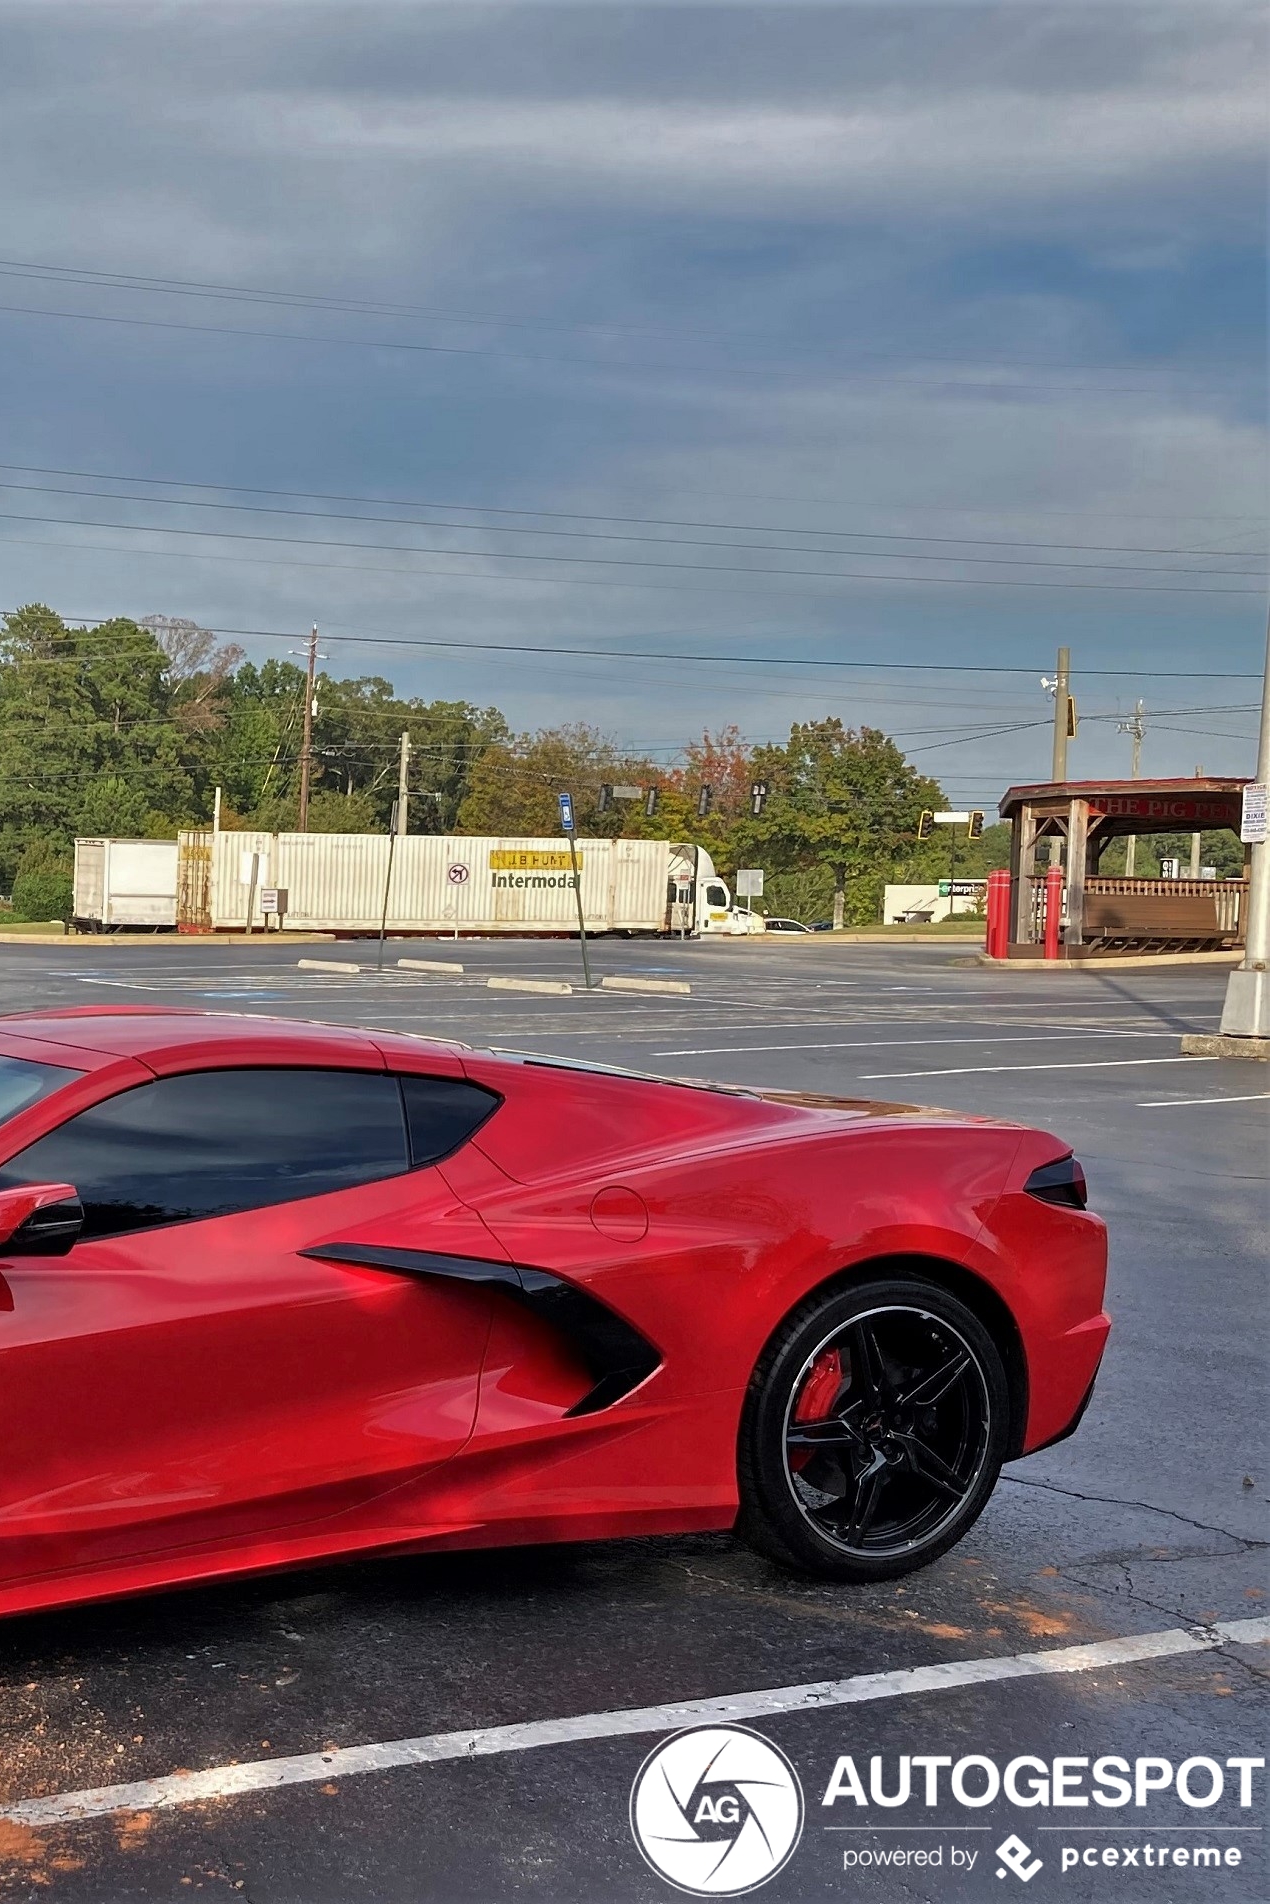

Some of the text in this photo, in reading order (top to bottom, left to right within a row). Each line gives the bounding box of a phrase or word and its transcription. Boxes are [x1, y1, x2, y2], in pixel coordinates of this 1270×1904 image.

[1089, 798, 1236, 819] THE PIG PEN
[533, 855, 566, 866] HUNT
